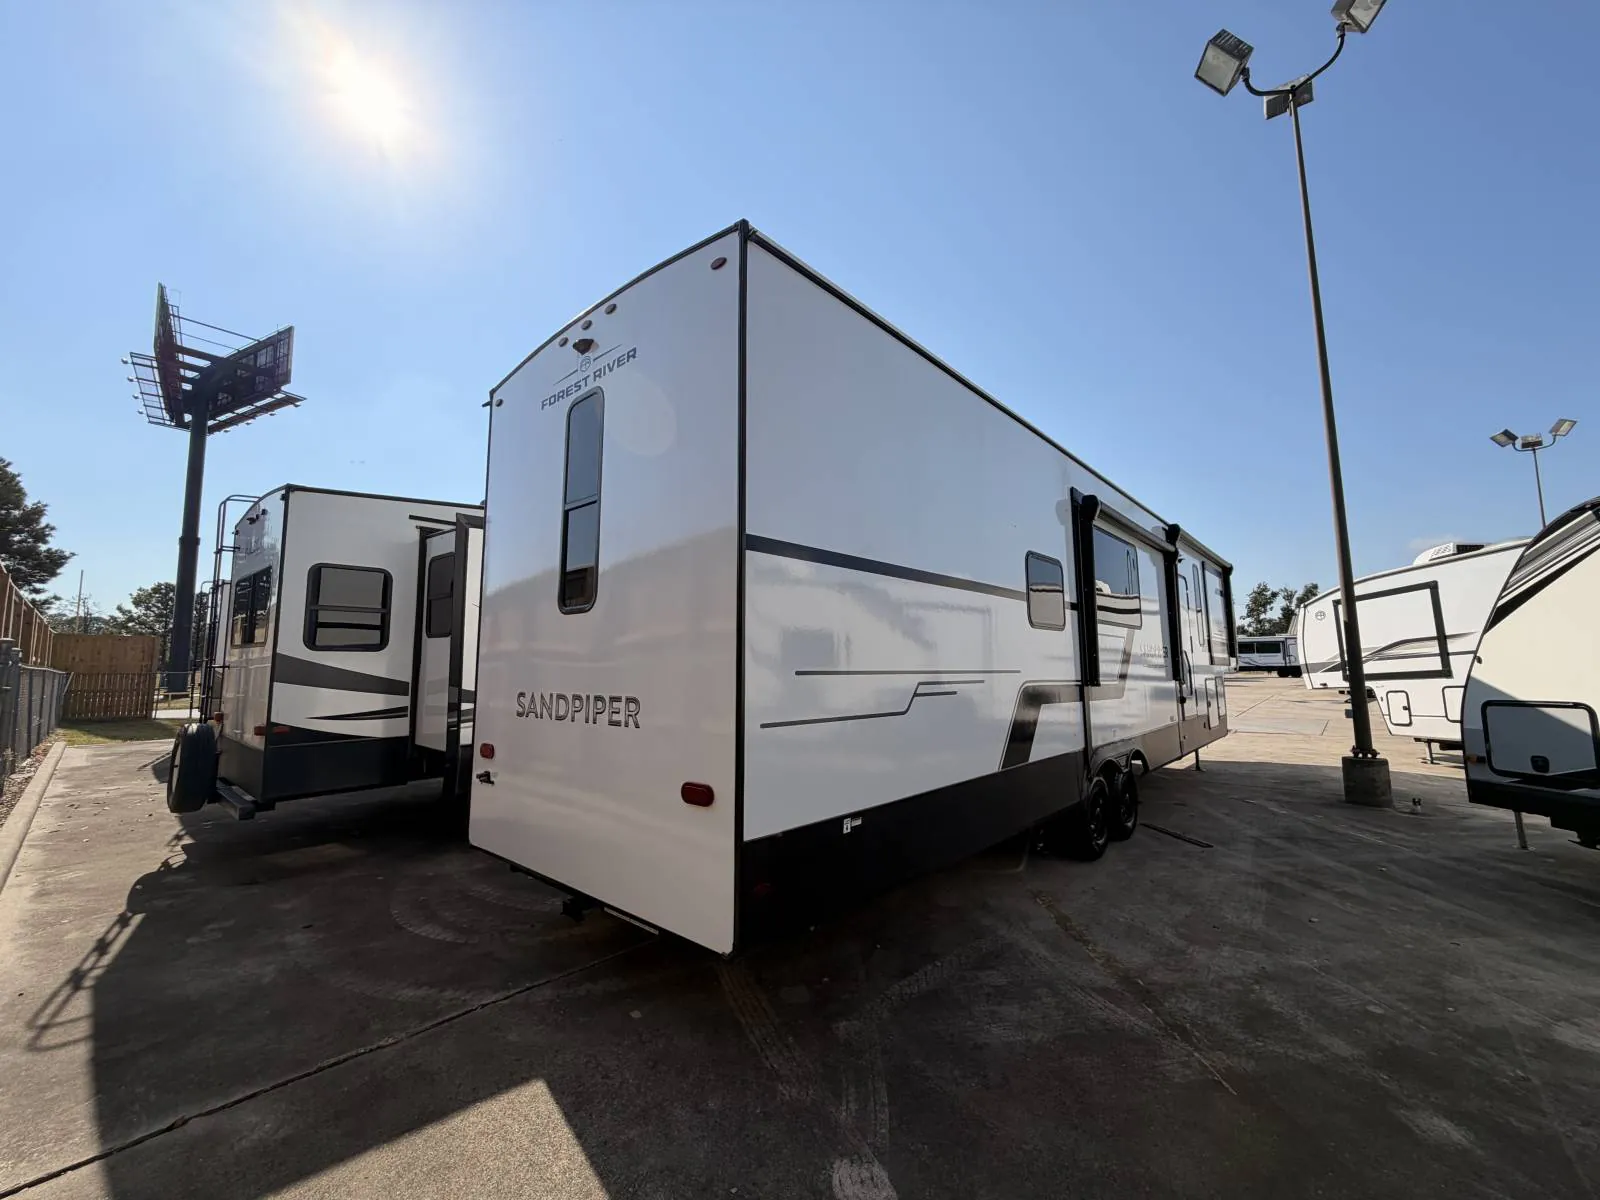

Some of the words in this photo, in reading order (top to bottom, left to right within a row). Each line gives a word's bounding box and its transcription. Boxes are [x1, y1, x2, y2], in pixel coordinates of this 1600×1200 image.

[541, 374, 590, 410] FOREST
[593, 347, 637, 382] RIVER
[516, 691, 641, 729] SANDPIPER
